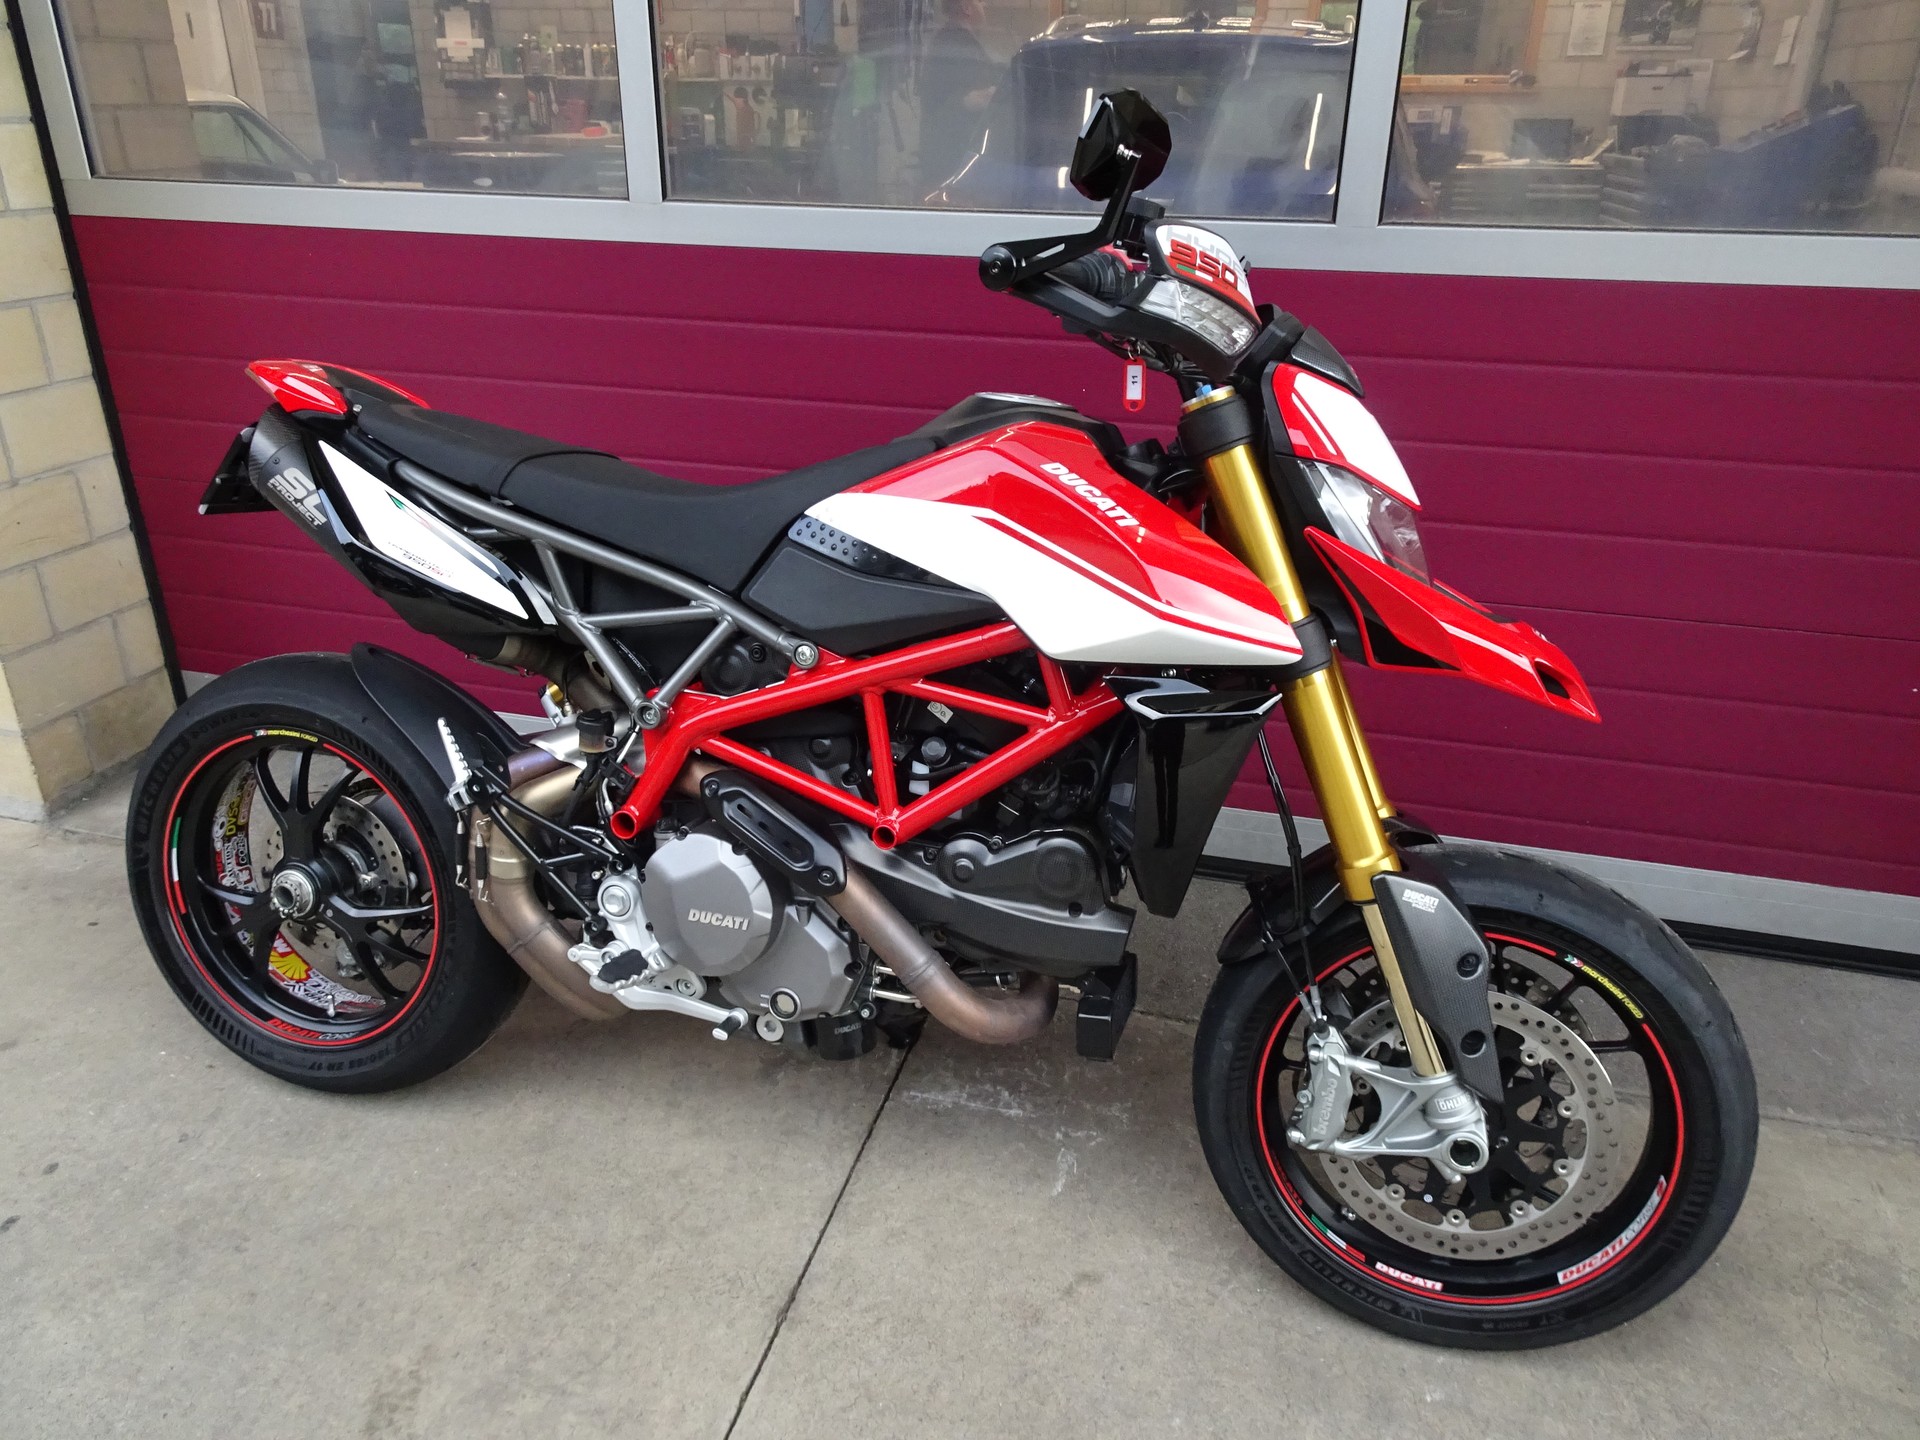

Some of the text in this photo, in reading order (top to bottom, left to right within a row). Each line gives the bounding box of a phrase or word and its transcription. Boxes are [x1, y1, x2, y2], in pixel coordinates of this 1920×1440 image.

[1169, 238, 1239, 291] 950
[1131, 375, 1138, 386] 11
[268, 477, 323, 526] PROJECT
[1040, 462, 1140, 527] DUCATI
[1402, 888, 1440, 908] DUCATI
[687, 908, 750, 932] DUCATI
[1581, 965, 1627, 1000] marchesini
[266, 1017, 322, 1039] DUCATI
[1313, 1078, 1338, 1136] brembo
[1561, 1236, 1625, 1281] DUCATI
[1374, 1261, 1444, 1292] DUCATI
